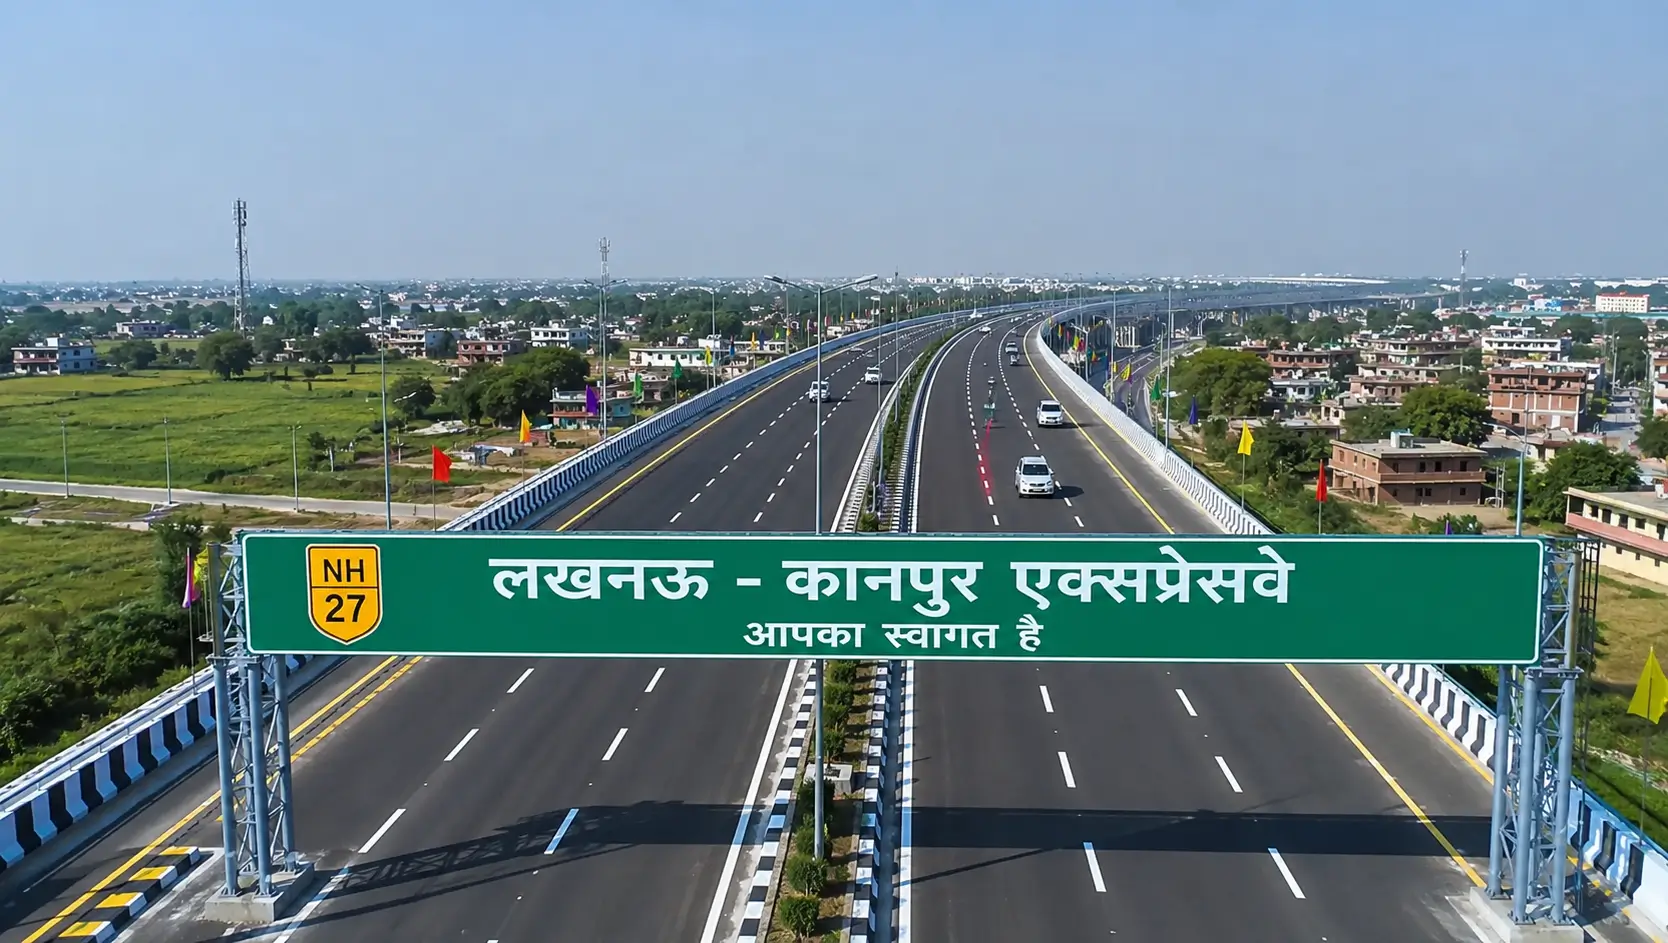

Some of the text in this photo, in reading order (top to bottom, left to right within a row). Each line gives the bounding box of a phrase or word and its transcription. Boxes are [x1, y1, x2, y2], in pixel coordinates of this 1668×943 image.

[324, 559, 365, 583] NH
[489, 545, 1296, 618] लखनऊ - कानपुर एक्सप्रेसवे
[326, 594, 366, 623] 27
[744, 614, 1044, 652] आपका स्वागत है
